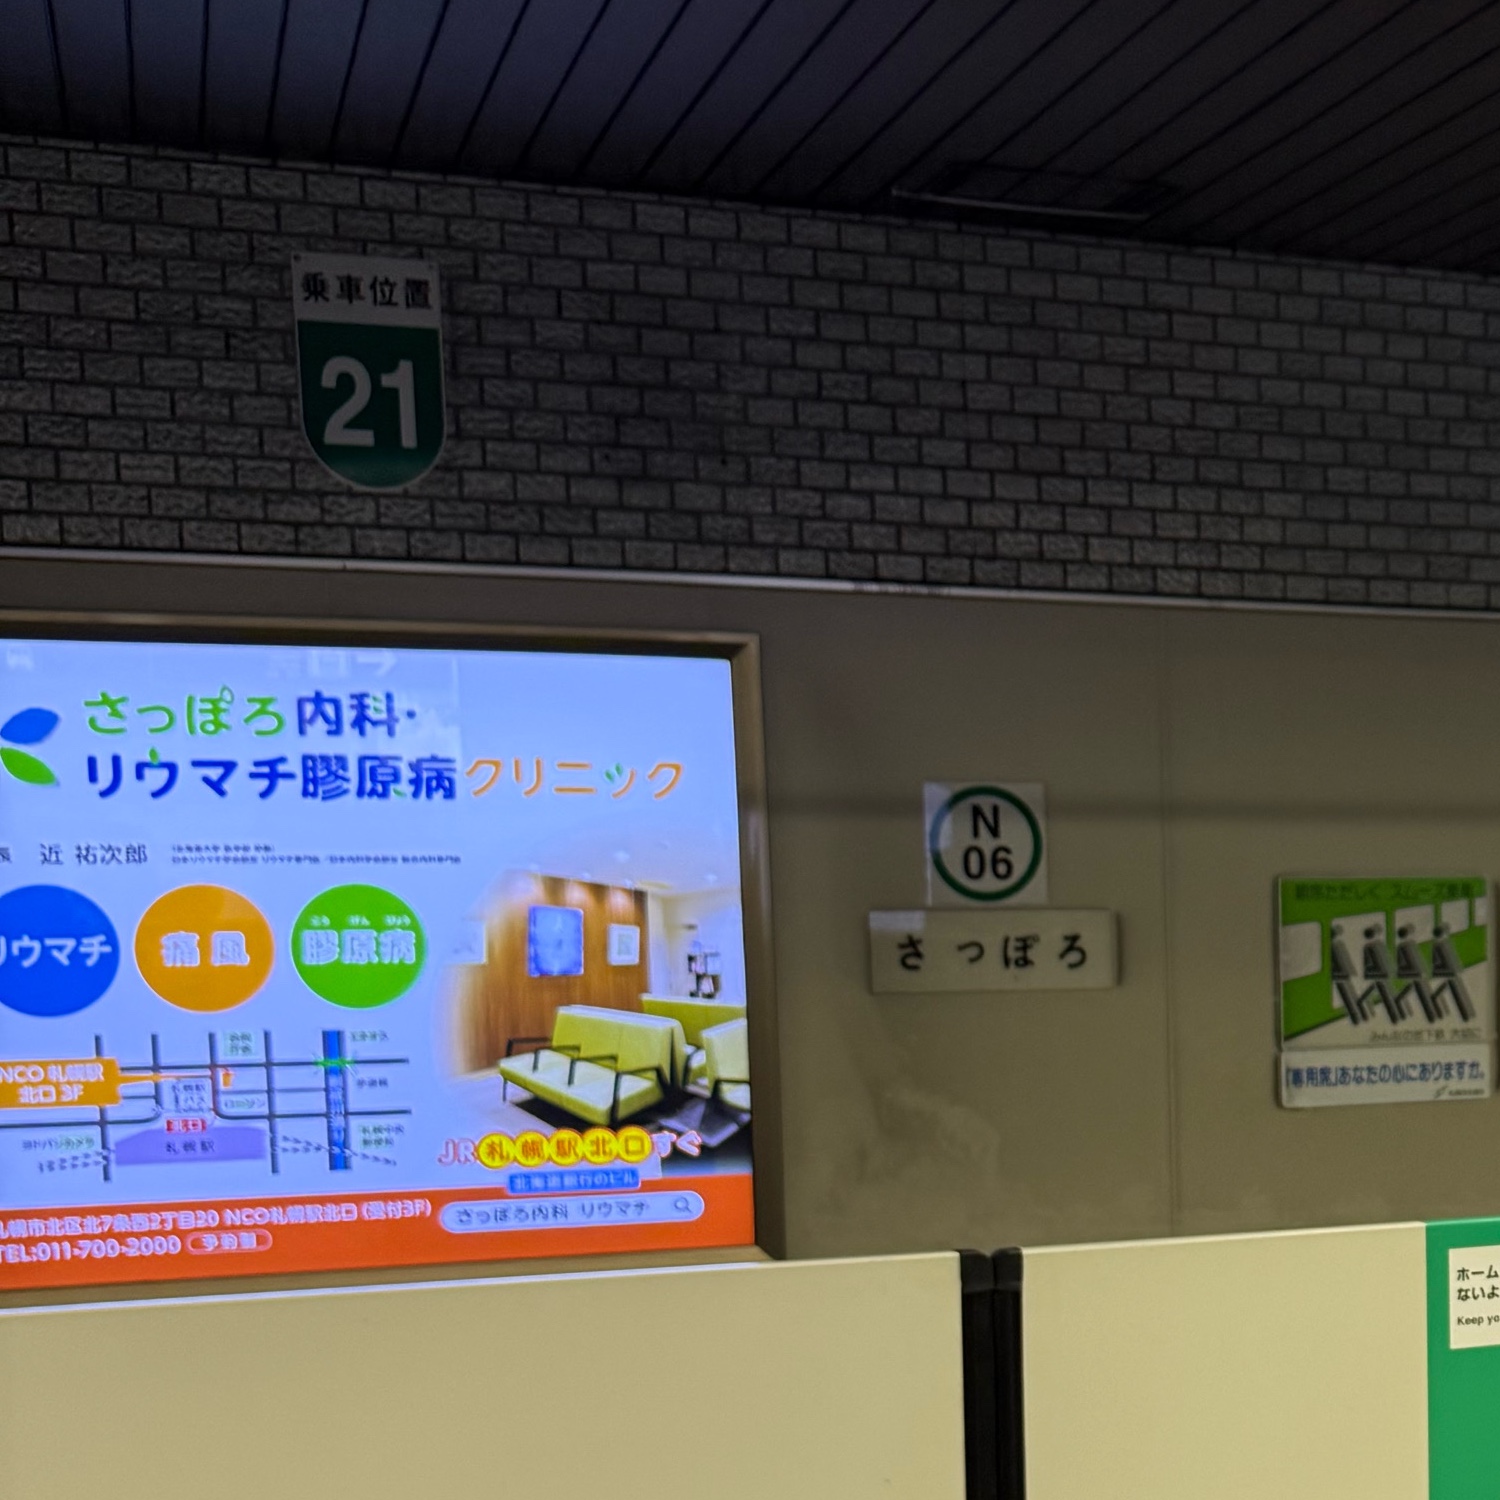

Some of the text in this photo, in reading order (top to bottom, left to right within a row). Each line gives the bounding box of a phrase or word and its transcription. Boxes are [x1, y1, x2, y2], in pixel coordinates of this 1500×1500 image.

[303, 271, 432, 310] 乗車位置
[321, 355, 418, 449] 21
[971, 804, 999, 839] N
[963, 845, 1013, 880] 06
[303, 927, 416, 967] 膠原病
[898, 933, 1088, 971] さっぽろ
[0, 1064, 45, 1083] NCO
[455, 1198, 649, 1223] さっぽろ内科 リウマチ
[1457, 1313, 1484, 1326] Keep
